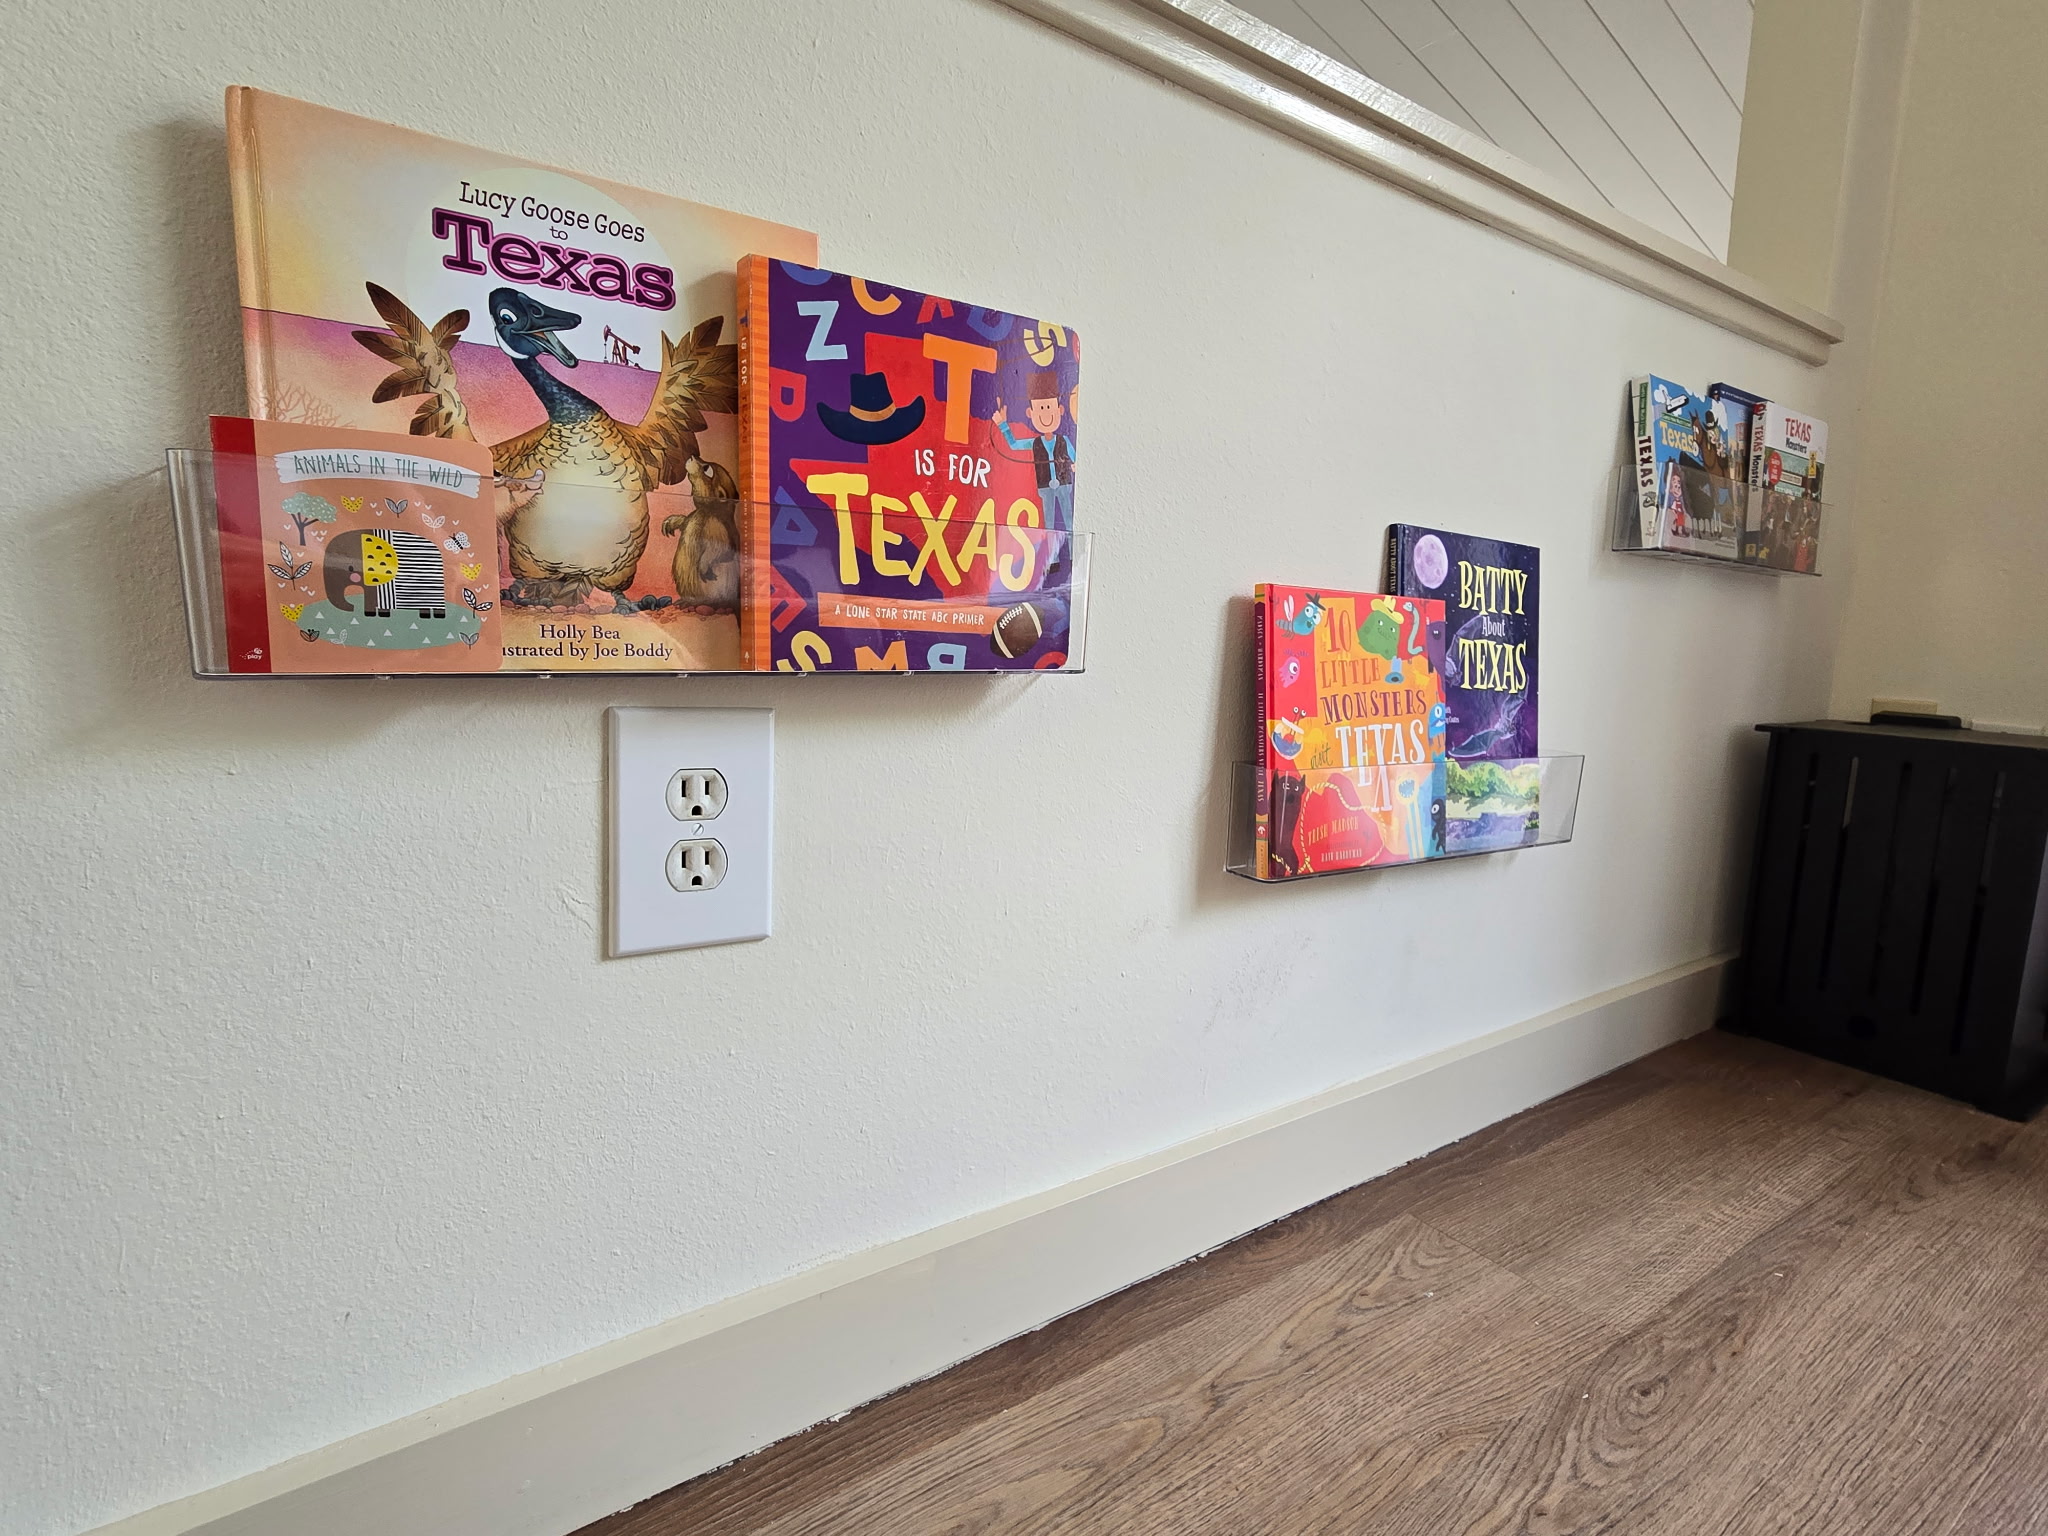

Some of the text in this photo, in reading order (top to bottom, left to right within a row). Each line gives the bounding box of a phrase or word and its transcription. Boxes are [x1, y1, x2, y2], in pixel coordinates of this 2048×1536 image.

[459, 181, 645, 242] Lucy Goose Goes
[549, 225, 568, 240] to
[432, 207, 676, 311] Texas
[797, 300, 848, 361] Z
[923, 332, 997, 444] T
[1659, 420, 1694, 453] Texas
[1753, 425, 1764, 452] TEXAS
[1784, 418, 1811, 443] TEXAS
[294, 454, 361, 475] ANIMALS
[369, 456, 385, 475] IN
[428, 464, 463, 488] WILD
[914, 449, 991, 488] IS FOR
[1639, 436, 1654, 487] TEXAS
[806, 472, 1040, 592] TEXAS
[1458, 561, 1528, 615] BATTY
[539, 624, 620, 643] Holly Bea
[835, 605, 985, 626] A LONE STAR STATE ABC PRIMER
[1324, 607, 1352, 652] 10
[1482, 616, 1506, 637] About
[570, 641, 589, 660] by
[593, 642, 619, 660] Joe
[624, 643, 673, 661] Boddy
[1458, 637, 1527, 694] TEXAS
[1320, 658, 1380, 688] LITTLE
[1320, 689, 1427, 726] MONSTERS
[1335, 719, 1425, 813] TEXAS
